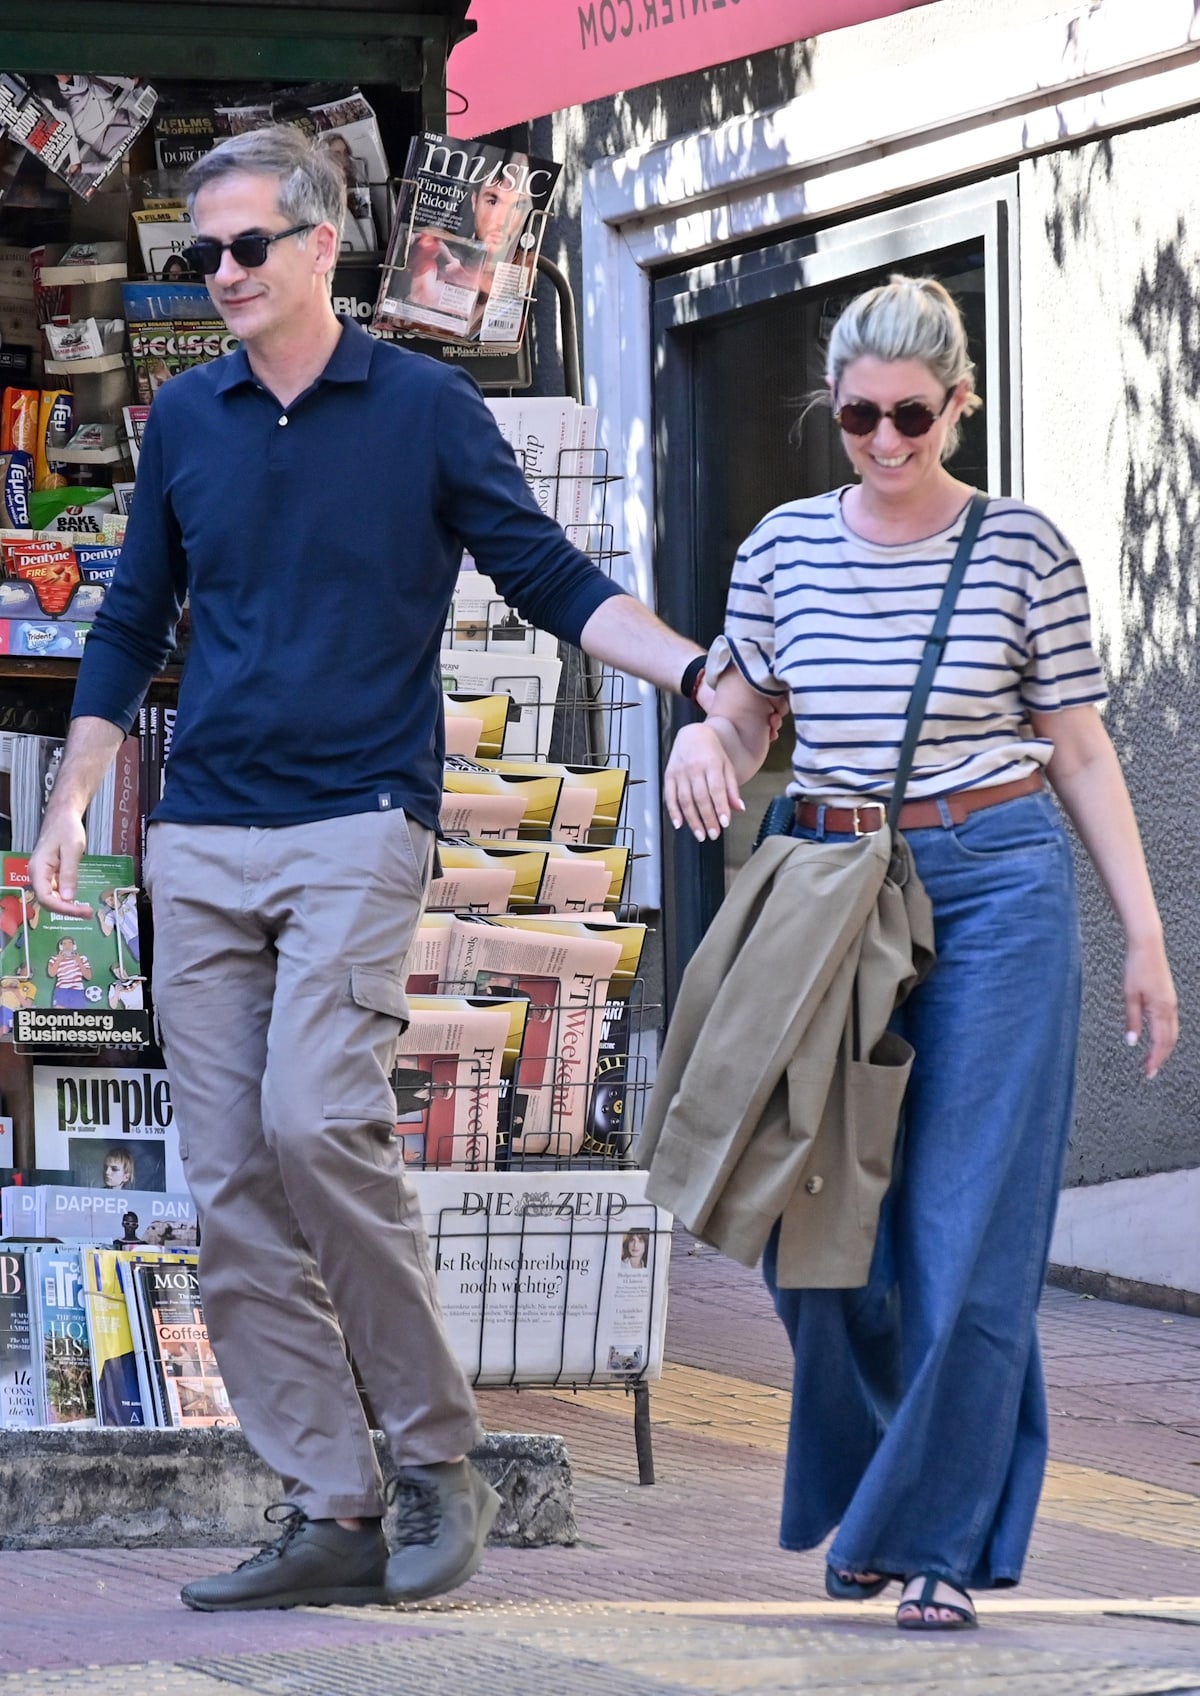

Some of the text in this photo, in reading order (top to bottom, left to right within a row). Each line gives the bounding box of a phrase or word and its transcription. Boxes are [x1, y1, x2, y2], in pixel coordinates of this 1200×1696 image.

[0, 101, 24, 127] THE
[10, 104, 44, 140] ROOM
[170, 118, 212, 129] FILMS
[418, 142, 553, 198] music
[417, 176, 469, 203] Timothy
[418, 191, 460, 214] Ridout
[145, 213, 171, 222] FILMS
[57, 515, 97, 527] BAKE
[20, 551, 70, 566] Dentyne
[26, 568, 48, 577] FIRE
[28, 632, 52, 641] Trident
[119, 756, 133, 813] Paper
[464, 936, 478, 967] SpaceX
[18, 1011, 114, 1030] Bloomberg
[18, 1027, 143, 1043] Businessweek
[56, 1073, 173, 1133] purple
[56, 1194, 190, 1218] DAPPER DAN
[461, 1192, 627, 1217] DIE ZEID
[438, 1252, 591, 1276] Ist Rechtschreibung
[460, 1275, 563, 1299] noch wichtig?
[159, 1326, 209, 1340] Coffee
